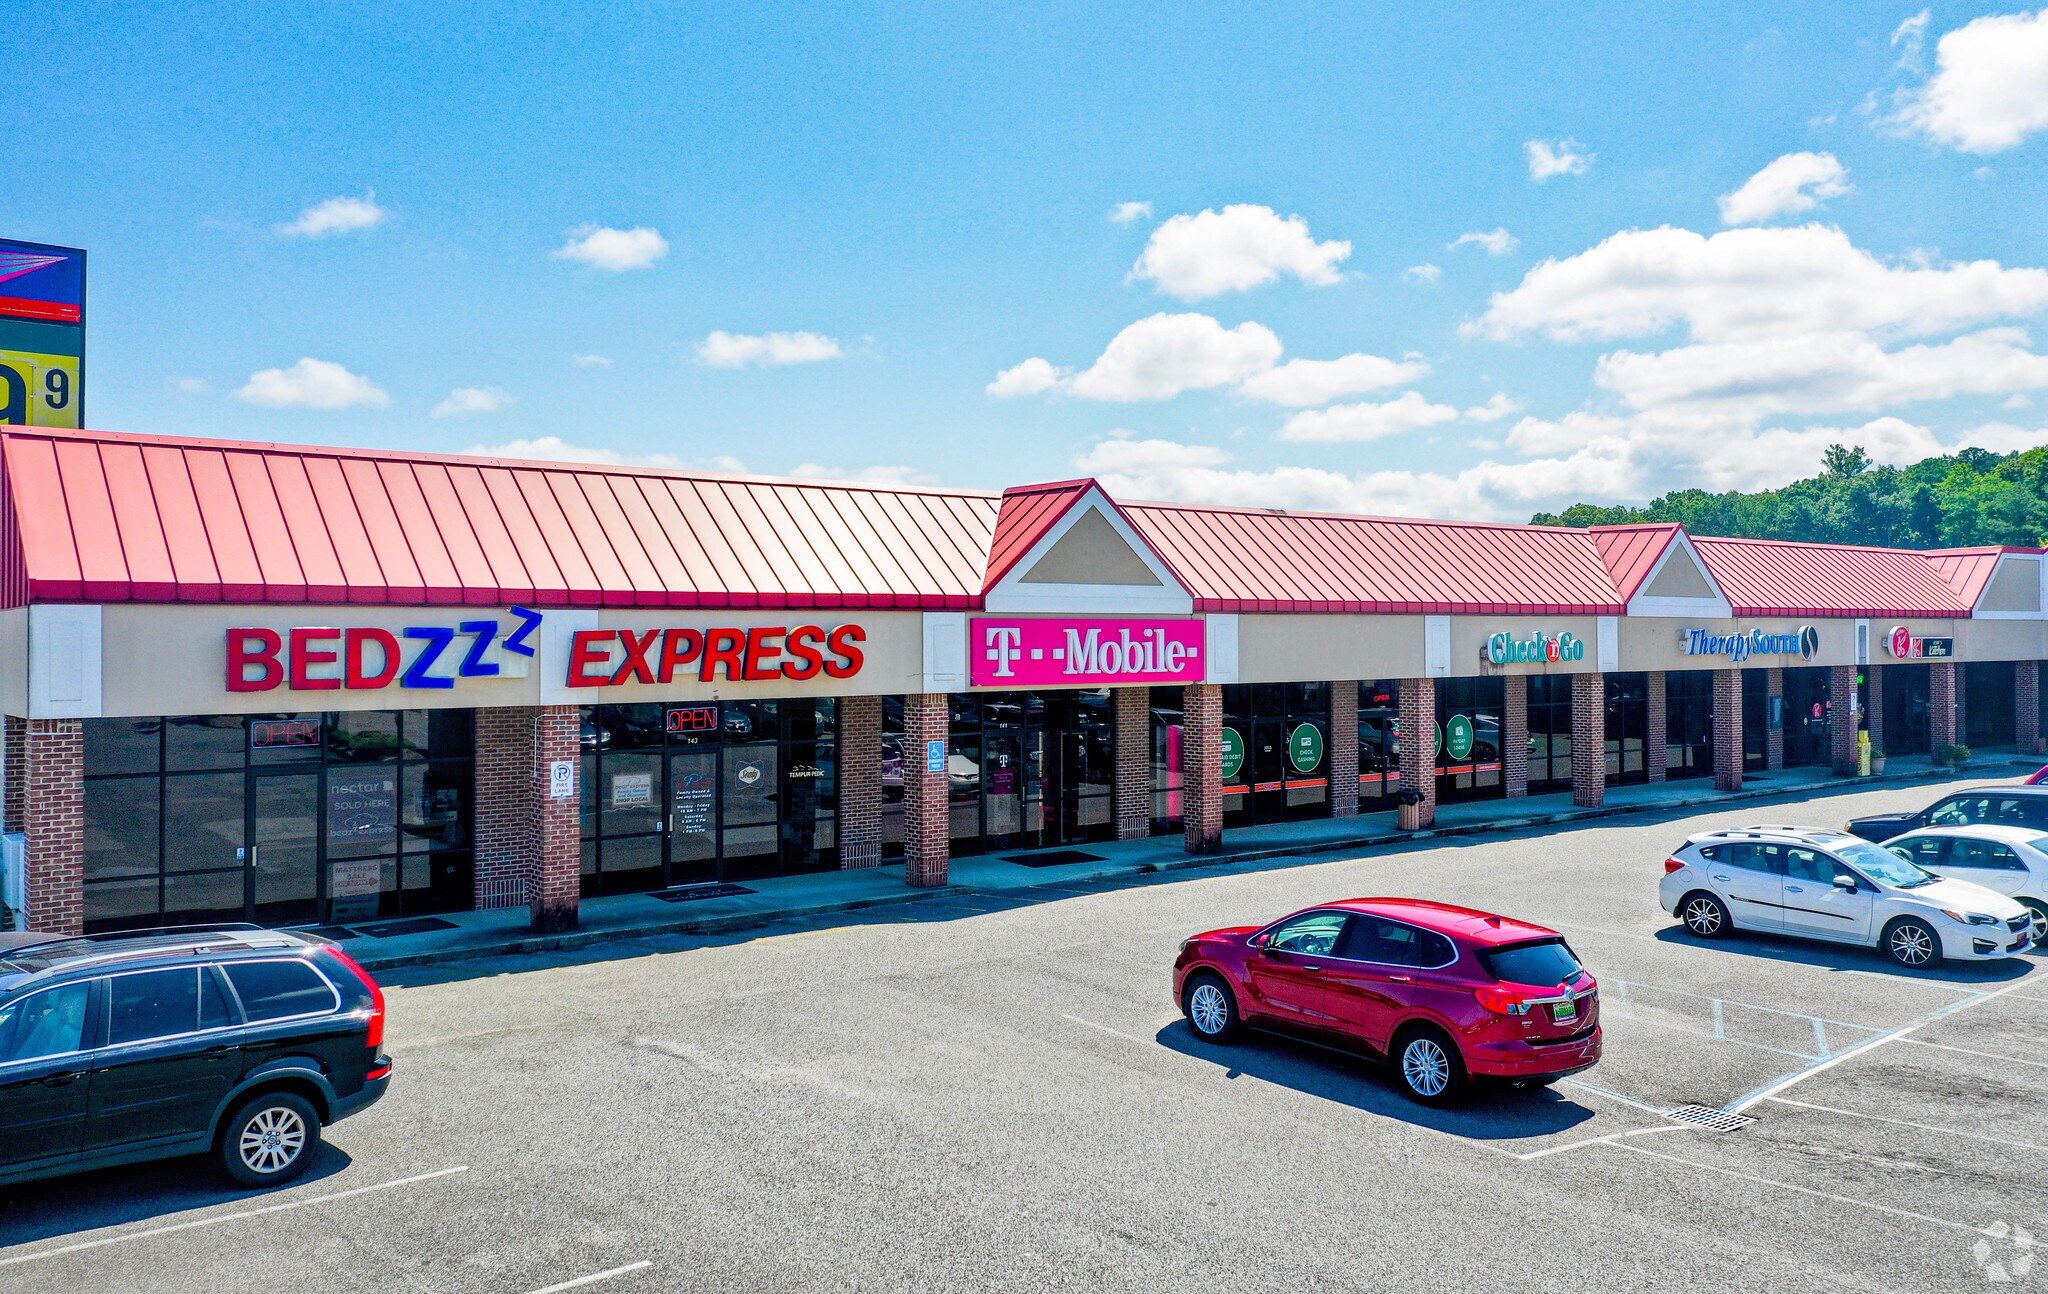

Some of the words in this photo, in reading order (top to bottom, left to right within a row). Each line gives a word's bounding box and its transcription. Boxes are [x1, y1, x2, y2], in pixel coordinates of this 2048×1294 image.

[45, 368, 69, 409] 9
[565, 624, 867, 688] EXPRESS
[1373, 694, 1391, 702] OPEN
[669, 709, 717, 731] OPEN
[254, 722, 318, 746] OPEN
[741, 769, 759, 780] Sealy
[331, 782, 380, 794] nectar
[334, 801, 362, 811] SOLD
[364, 799, 390, 808] HERE
[335, 864, 378, 874] MATTRESS
[346, 873, 367, 881] SALE
